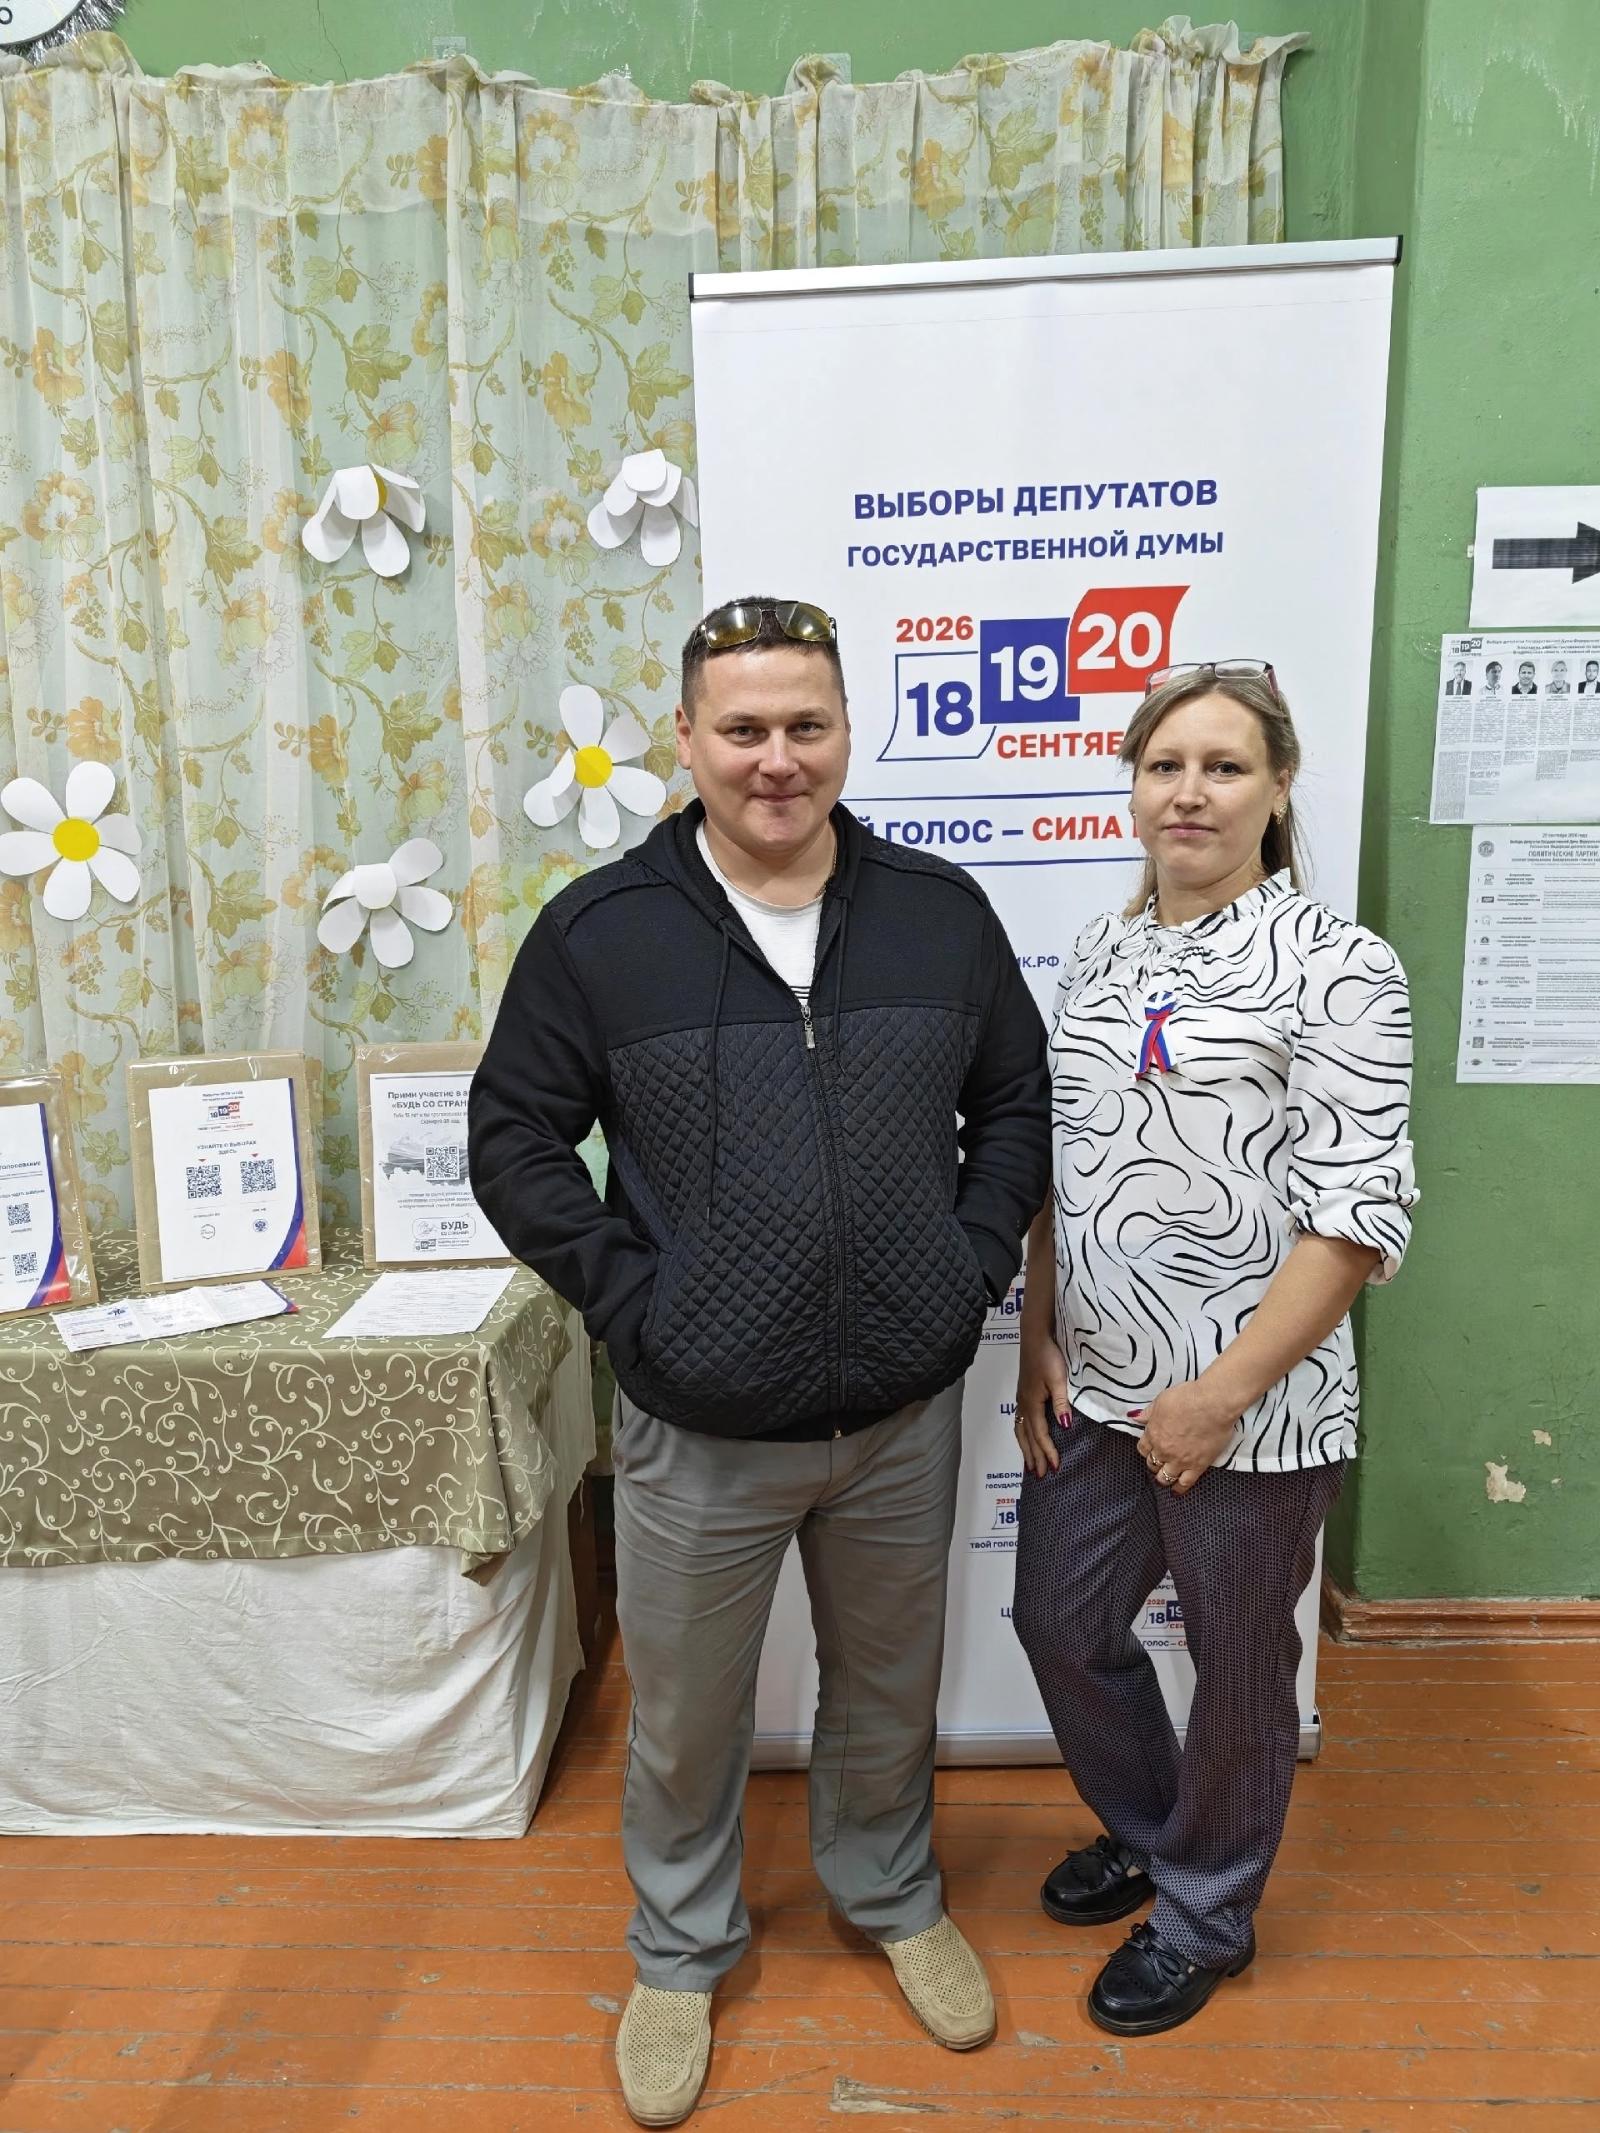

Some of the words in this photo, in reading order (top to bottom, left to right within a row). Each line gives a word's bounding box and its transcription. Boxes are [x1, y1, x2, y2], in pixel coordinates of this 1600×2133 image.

[854, 487, 1004, 519] ВЫБОРЫ
[1013, 479, 1218, 516] ДЕПУТАТОВ
[848, 529, 1128, 568] ГОСУДАРСТВЕННОЙ
[1135, 531, 1224, 560] ДУМЫ
[896, 615, 974, 643] 2026
[906, 680, 975, 737] 18
[989, 644, 1060, 702] 19
[1076, 610, 1163, 670] 20
[886, 819, 993, 845] ГОЛОС
[1032, 815, 1123, 842] СИЛА
[388, 1091, 417, 1100] Прими
[422, 1100, 436, 1108] СО
[440, 1221, 469, 1231] БУДЬ
[992, 1331, 1020, 1341] ГОЛОС
[986, 1472, 1022, 1480] ВЫБОРЫ
[998, 1511, 1016, 1525] 18
[969, 1540, 992, 1549] ТВОЙ
[1149, 1612, 1166, 1624] 18
